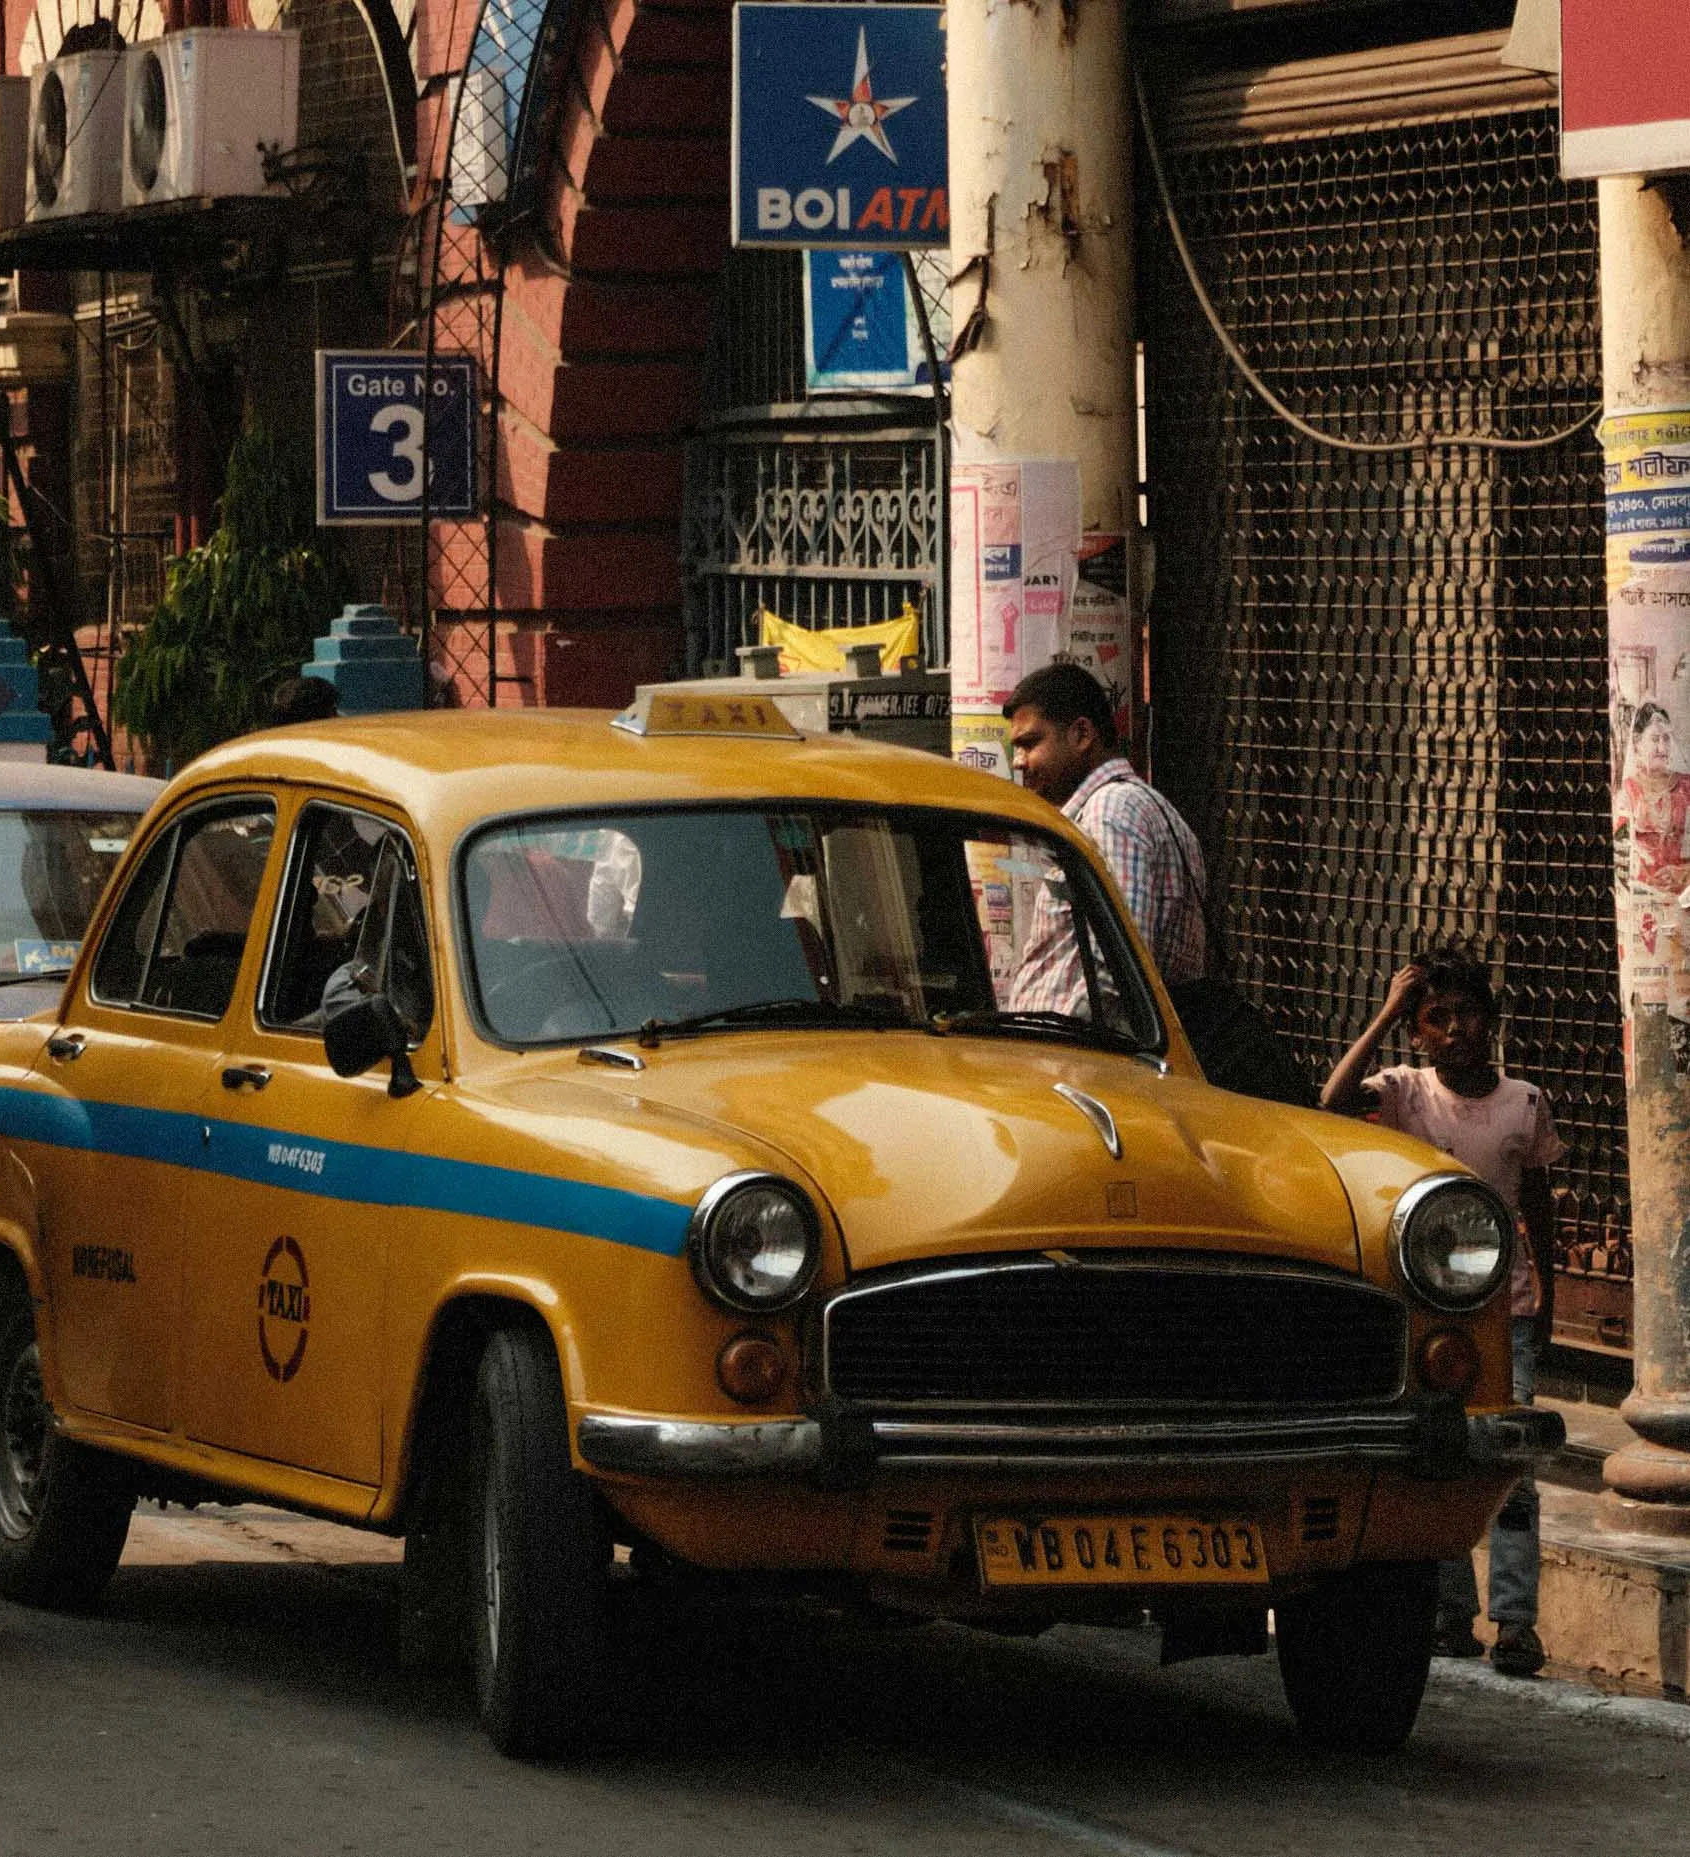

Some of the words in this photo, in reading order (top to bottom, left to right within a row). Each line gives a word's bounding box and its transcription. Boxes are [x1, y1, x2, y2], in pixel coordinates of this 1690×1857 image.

[757, 187, 850, 230] BOI
[347, 373, 406, 397] Gate
[367, 403, 435, 502] 3
[663, 701, 767, 727] TAXI
[267, 1279, 303, 1322] TAXI
